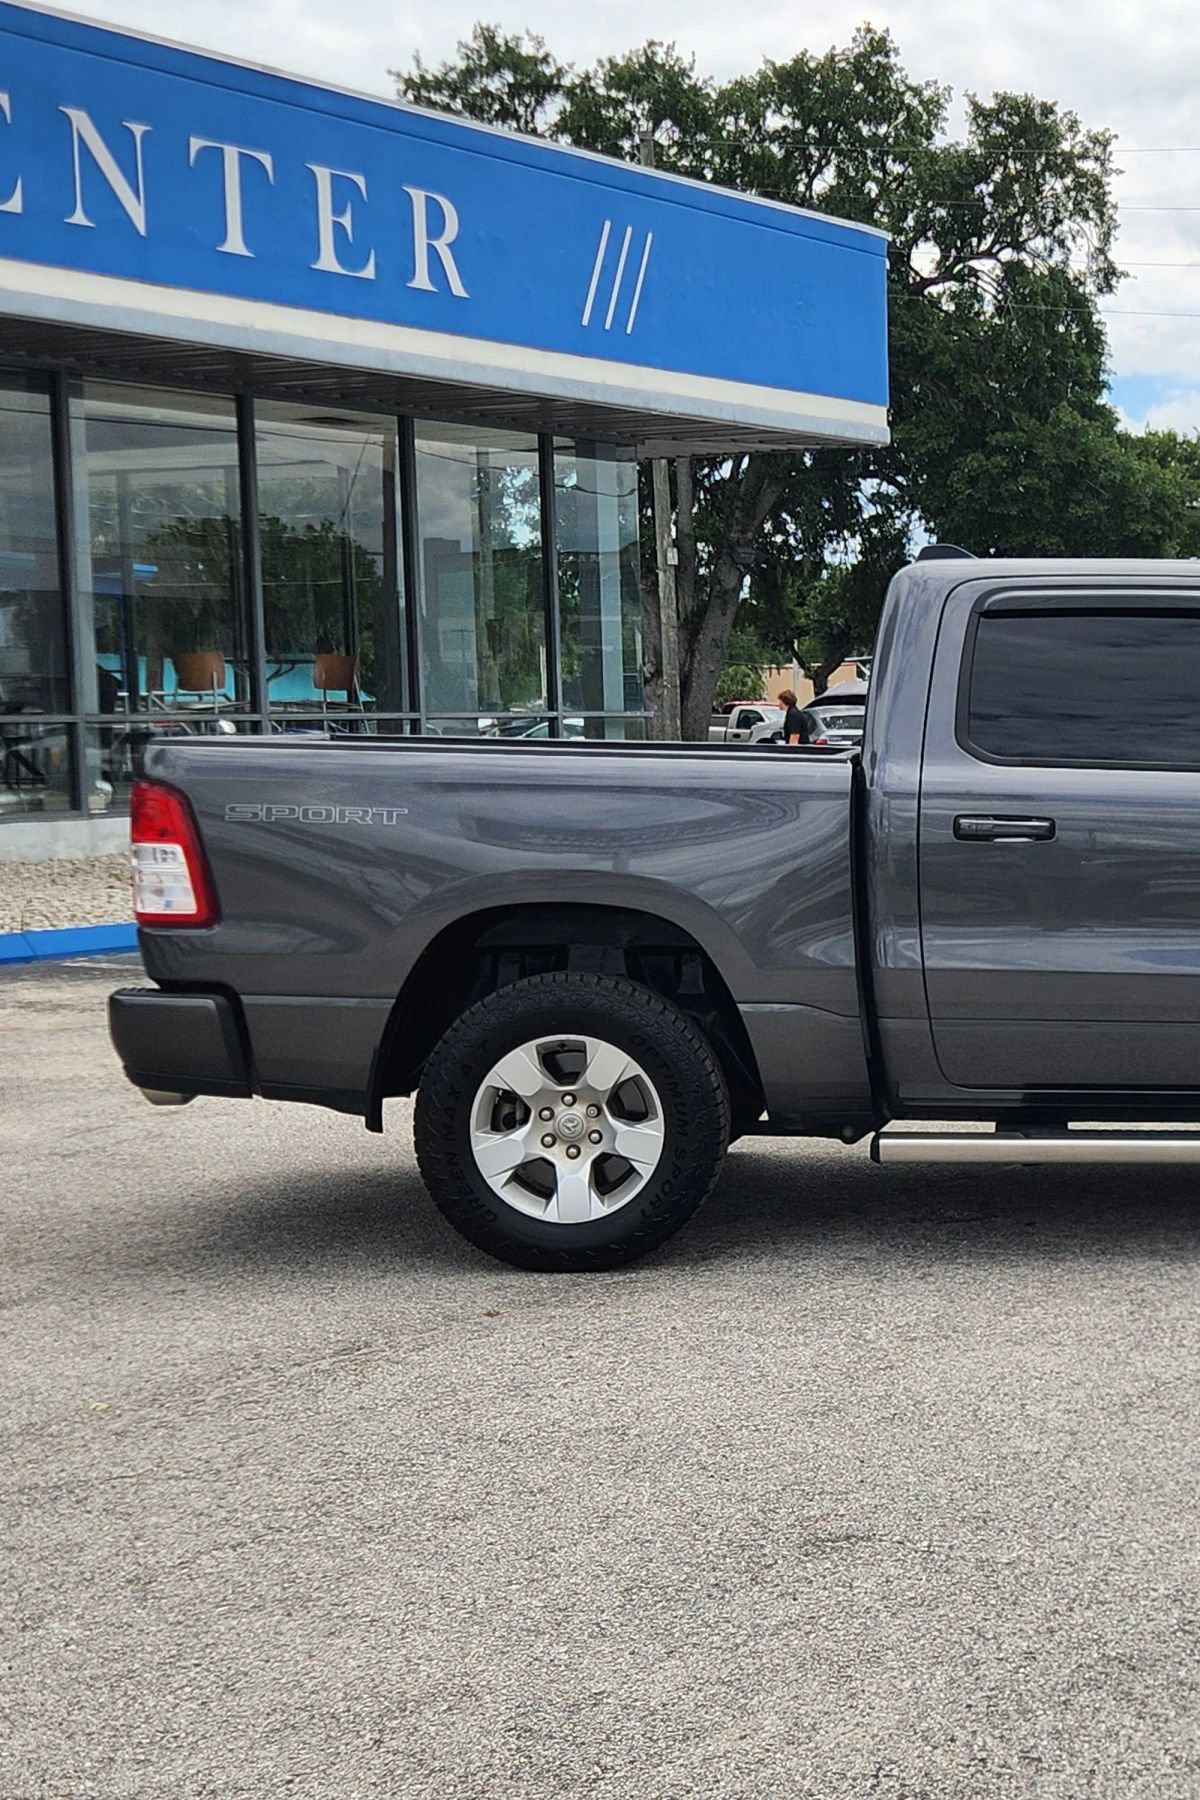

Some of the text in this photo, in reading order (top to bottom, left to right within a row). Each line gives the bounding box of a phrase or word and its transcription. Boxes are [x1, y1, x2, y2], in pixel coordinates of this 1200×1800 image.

[0, 93, 470, 298] NTER
[225, 804, 409, 825] SPORT
[639, 1145, 688, 1219] SPORT
